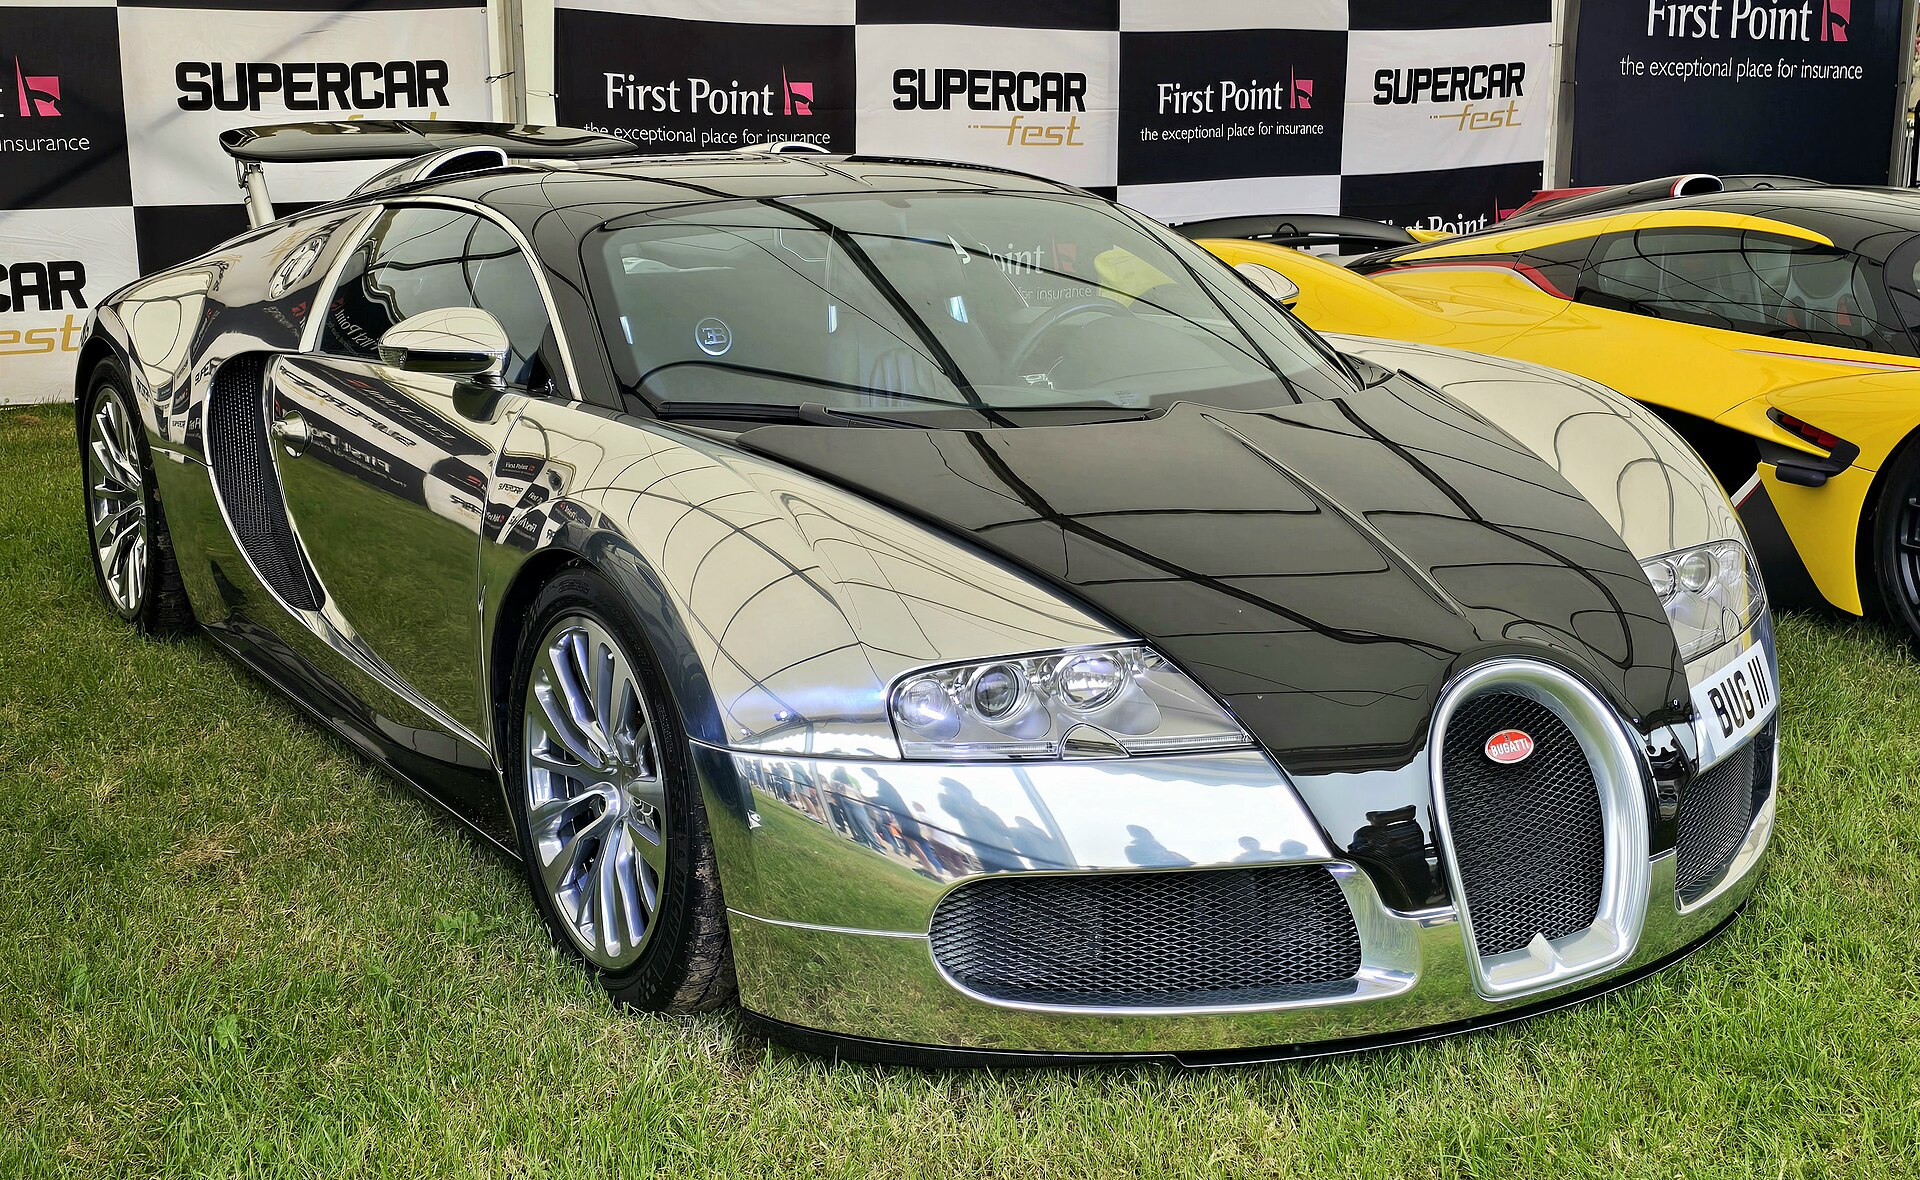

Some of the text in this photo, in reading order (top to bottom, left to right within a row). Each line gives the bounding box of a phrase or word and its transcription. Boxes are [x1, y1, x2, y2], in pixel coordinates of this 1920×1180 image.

[1647, 0, 1812, 42] First Point
[175, 60, 450, 111] SUPERCAR
[1373, 61, 1526, 105] SUPERCAR
[1620, 55, 1863, 82] the exceptional place for insurance
[603, 72, 774, 116] First Point
[892, 68, 1087, 113] SUPERCAR
[1156, 79, 1283, 115] First Point
[981, 115, 1084, 146] fest
[1140, 121, 1324, 143] the exceptional place for insurance
[1440, 100, 1522, 132] fest
[583, 121, 831, 147] the exceptional place for insurance
[1036, 286, 1092, 300] insurance
[1707, 670, 1755, 739] BUG
[1490, 738, 1530, 757] BUGATTI
